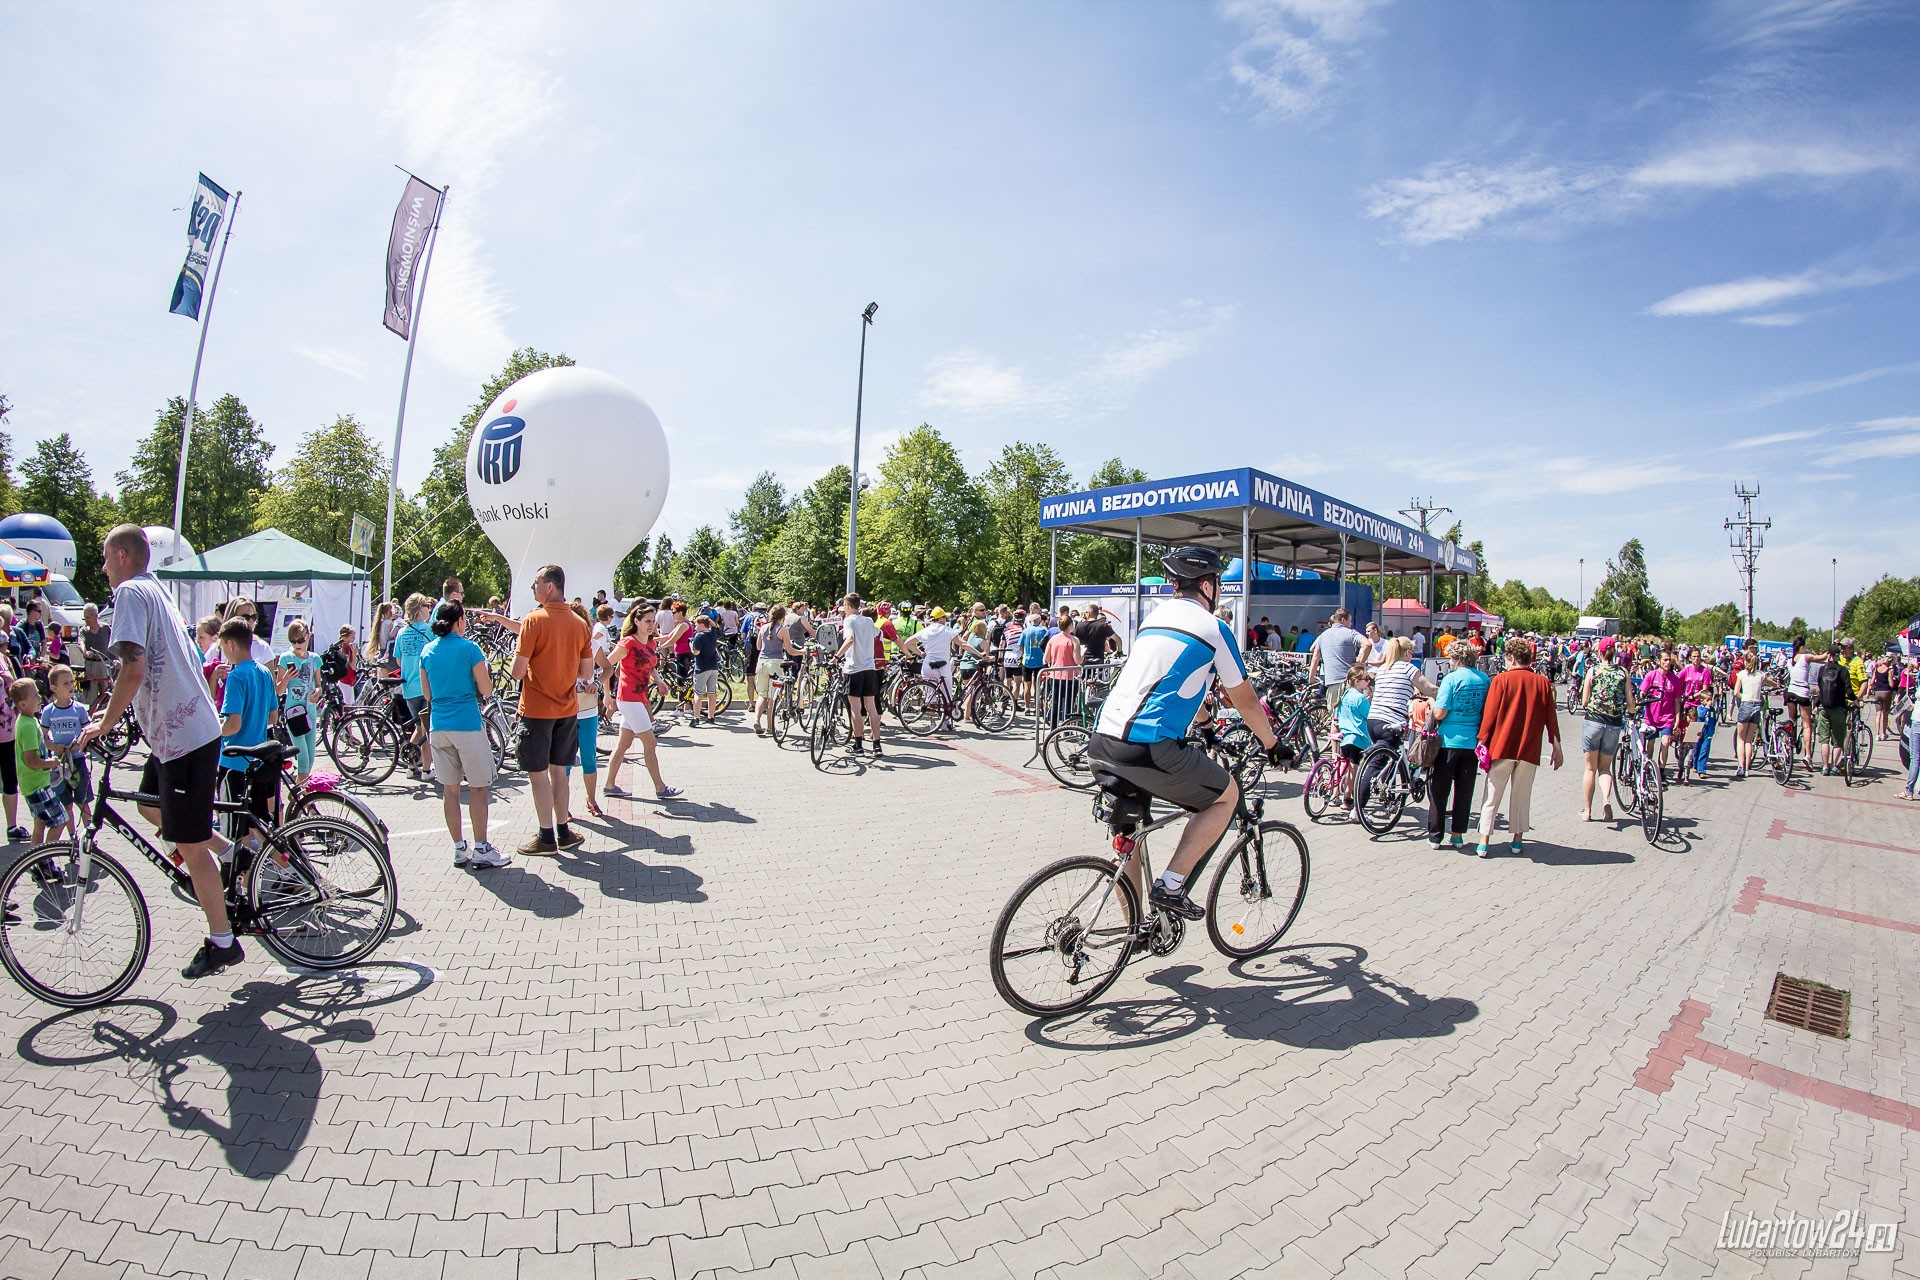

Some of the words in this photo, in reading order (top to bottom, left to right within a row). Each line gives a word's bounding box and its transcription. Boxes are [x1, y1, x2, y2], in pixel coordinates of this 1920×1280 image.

[397, 197, 424, 292] WIŚNIOWSKI
[503, 502, 549, 521] Polski
[1043, 498, 1096, 520] MYJNIA
[1102, 479, 1240, 512] BEZDOTYKOWA
[1254, 477, 1313, 517] MYJNIA
[1323, 500, 1402, 546] BEZDOTYKOWA
[1220, 584, 1241, 593] ÓWKA
